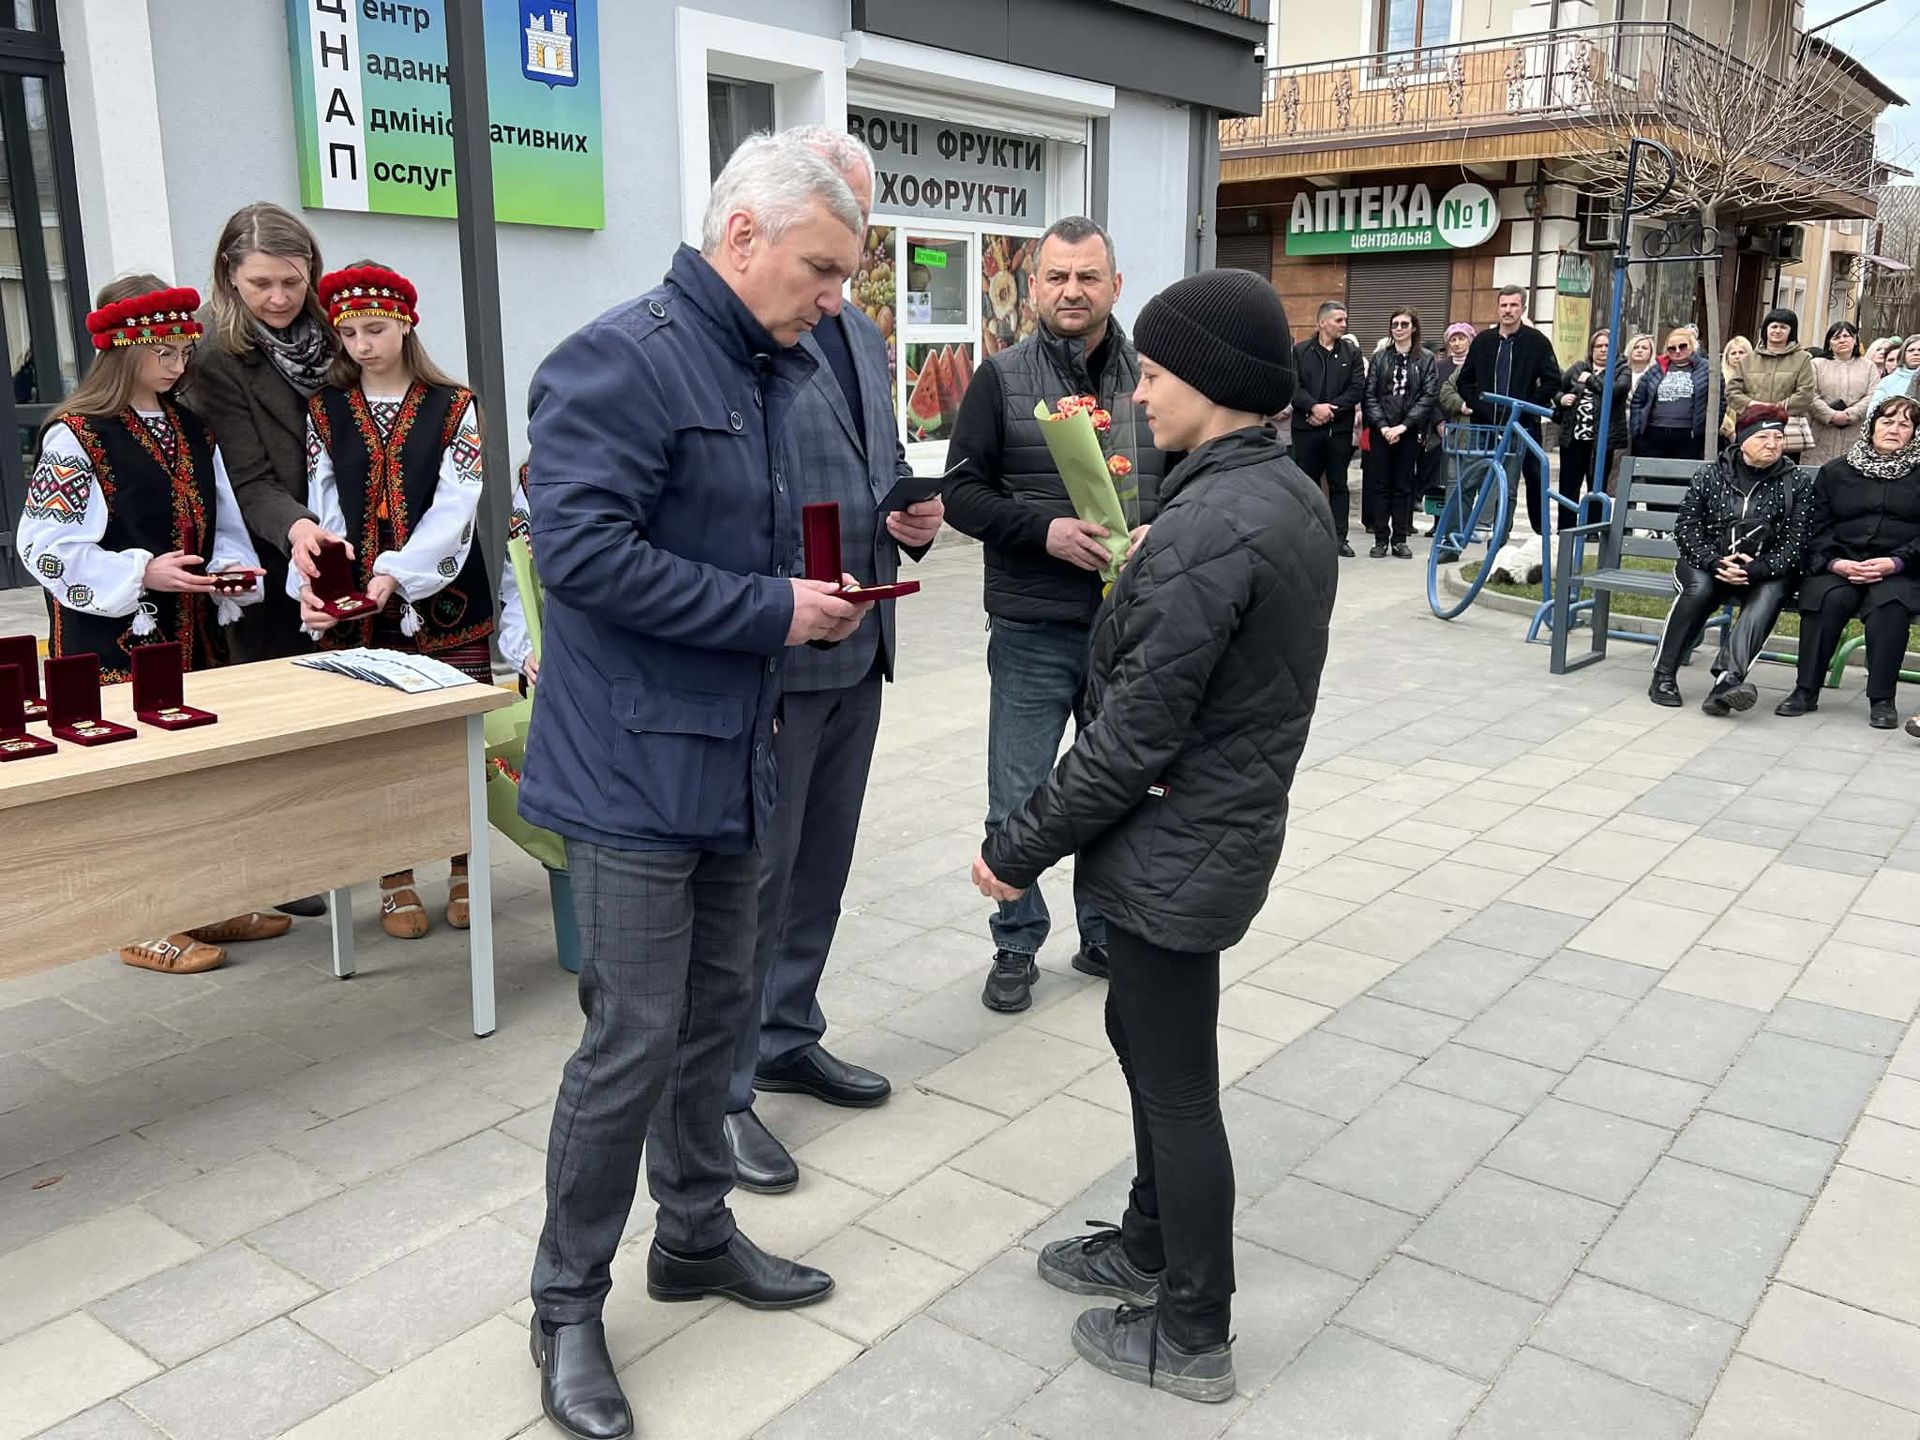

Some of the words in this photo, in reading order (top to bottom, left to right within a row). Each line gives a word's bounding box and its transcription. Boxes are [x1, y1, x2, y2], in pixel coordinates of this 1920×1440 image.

[362, 0, 430, 34] ентр
[366, 53, 452, 86] аданн
[370, 107, 588, 154] дмінісативних
[847, 114, 918, 156] ВОЧІ
[936, 129, 1042, 171] ФРУКТИ
[373, 161, 453, 192] ослуг
[874, 171, 1028, 218] ХОФРУКТИ
[1290, 183, 1433, 234] АПТЕКА
[1351, 231, 1432, 249] центральна
